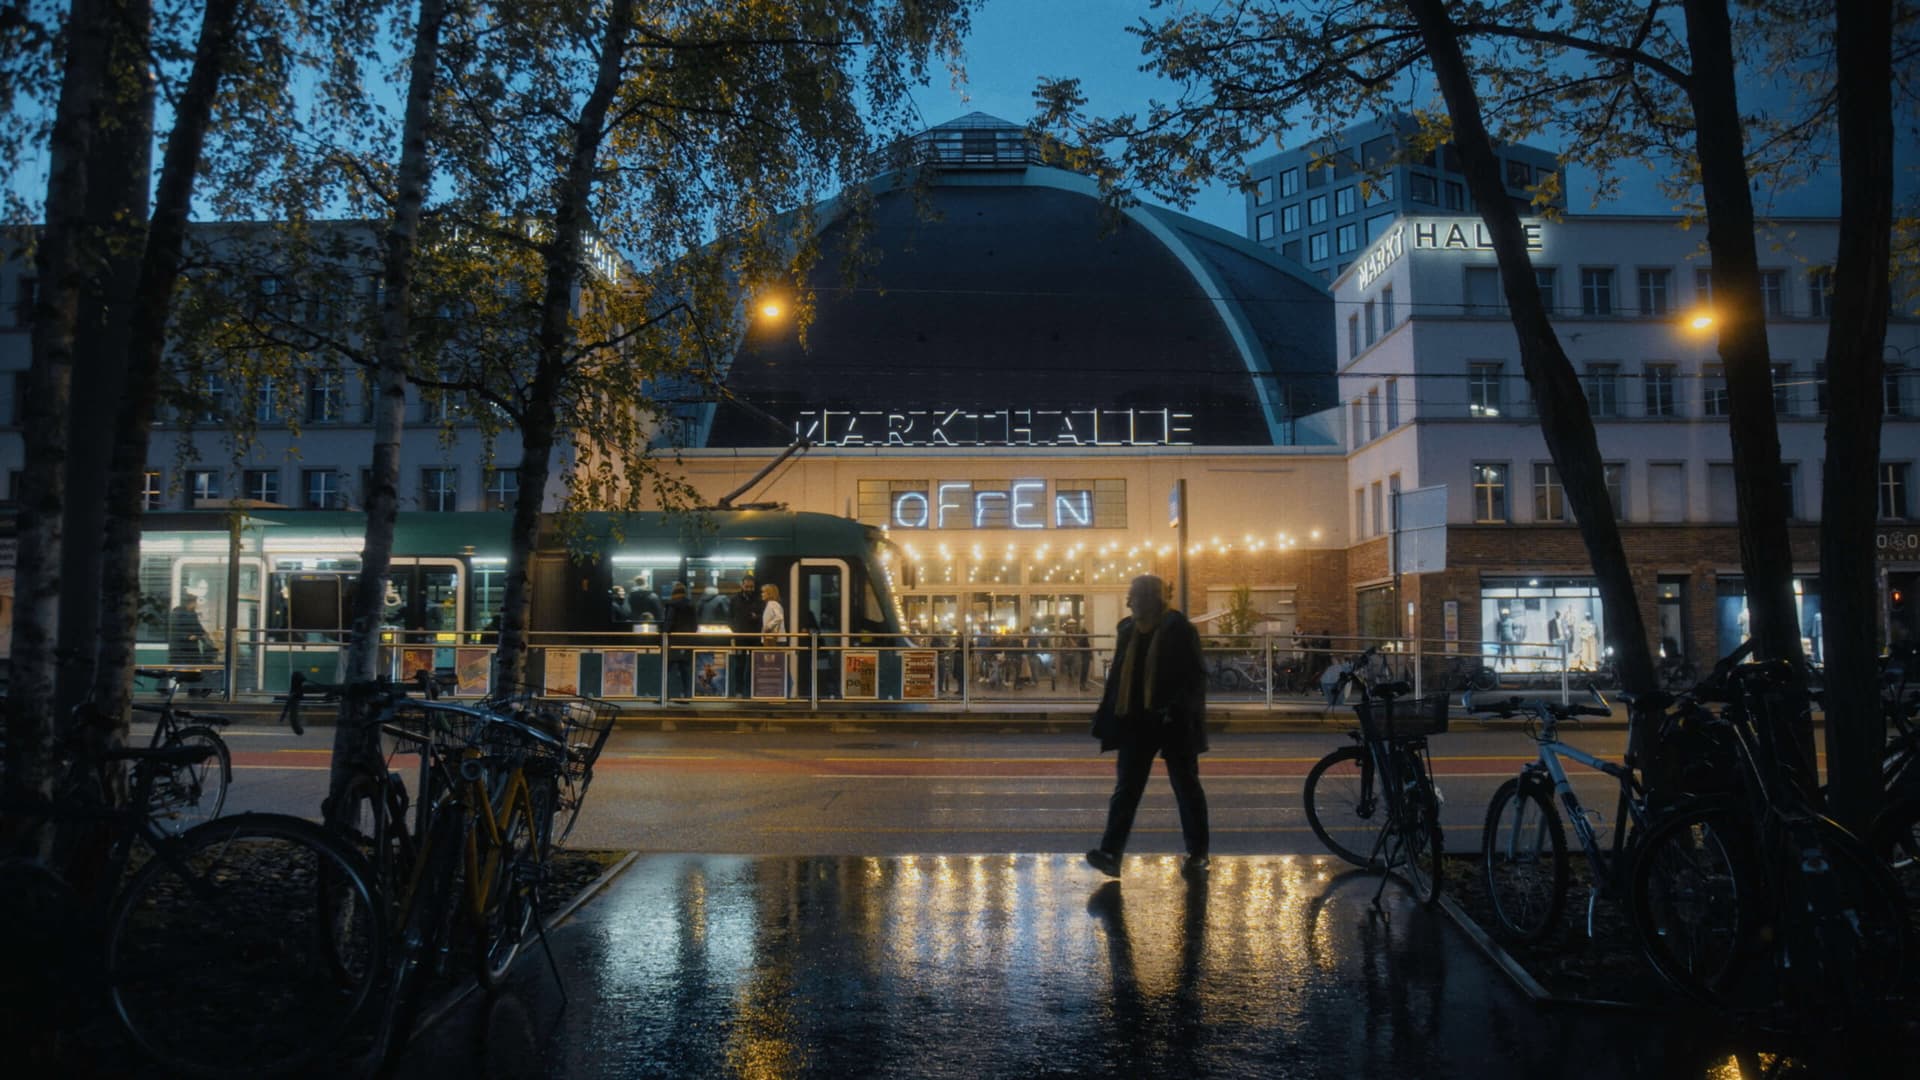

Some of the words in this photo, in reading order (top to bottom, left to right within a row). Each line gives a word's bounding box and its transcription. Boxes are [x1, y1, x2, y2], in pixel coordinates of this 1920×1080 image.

[1413, 223, 1544, 252] HALE
[1359, 225, 1405, 292] MARKT
[789, 408, 1193, 446] MARKTHALLE
[896, 483, 1090, 528] OFFEN
